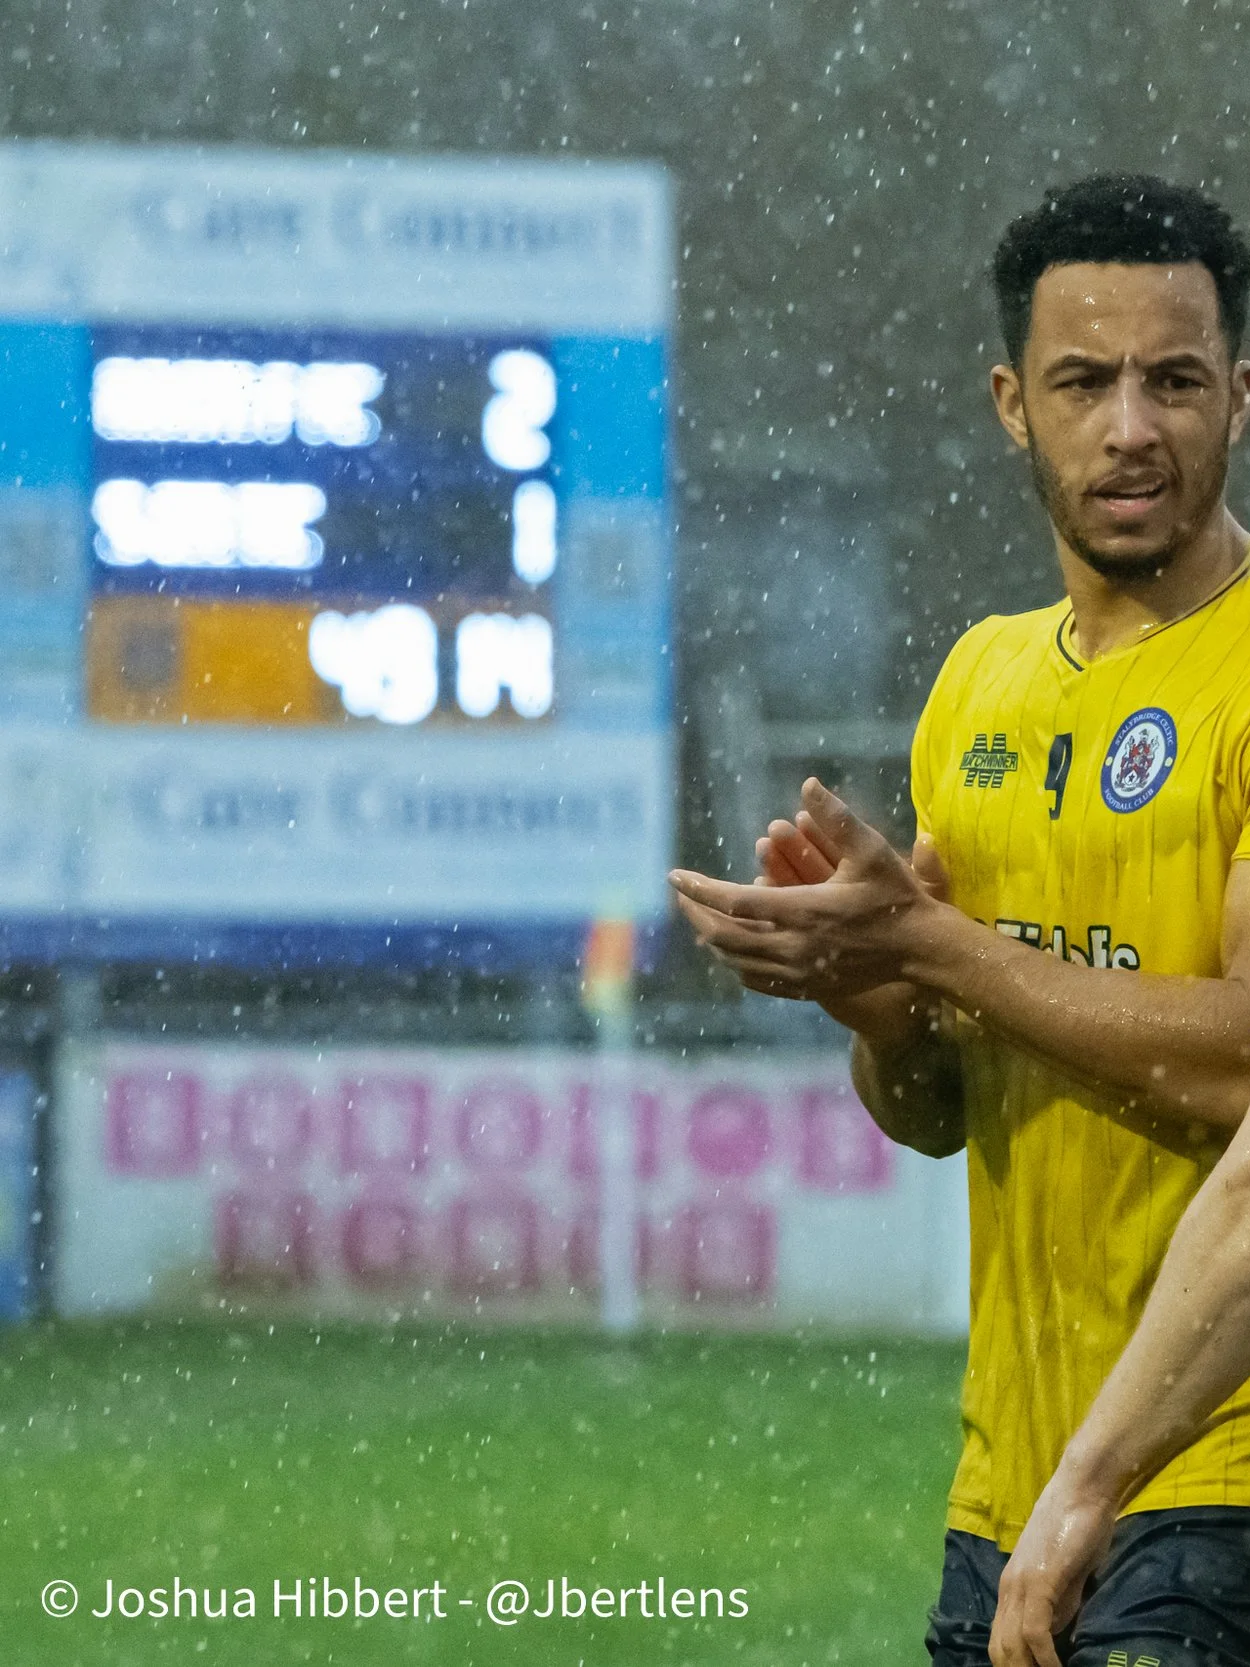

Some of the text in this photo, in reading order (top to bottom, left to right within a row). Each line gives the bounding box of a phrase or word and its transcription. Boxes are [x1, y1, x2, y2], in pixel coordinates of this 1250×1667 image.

[1114, 712, 1174, 747] STALYBRIDGE CELTIC
[1044, 732, 1072, 820] 9
[1104, 788, 1154, 810] FOOTBALL CLUB
